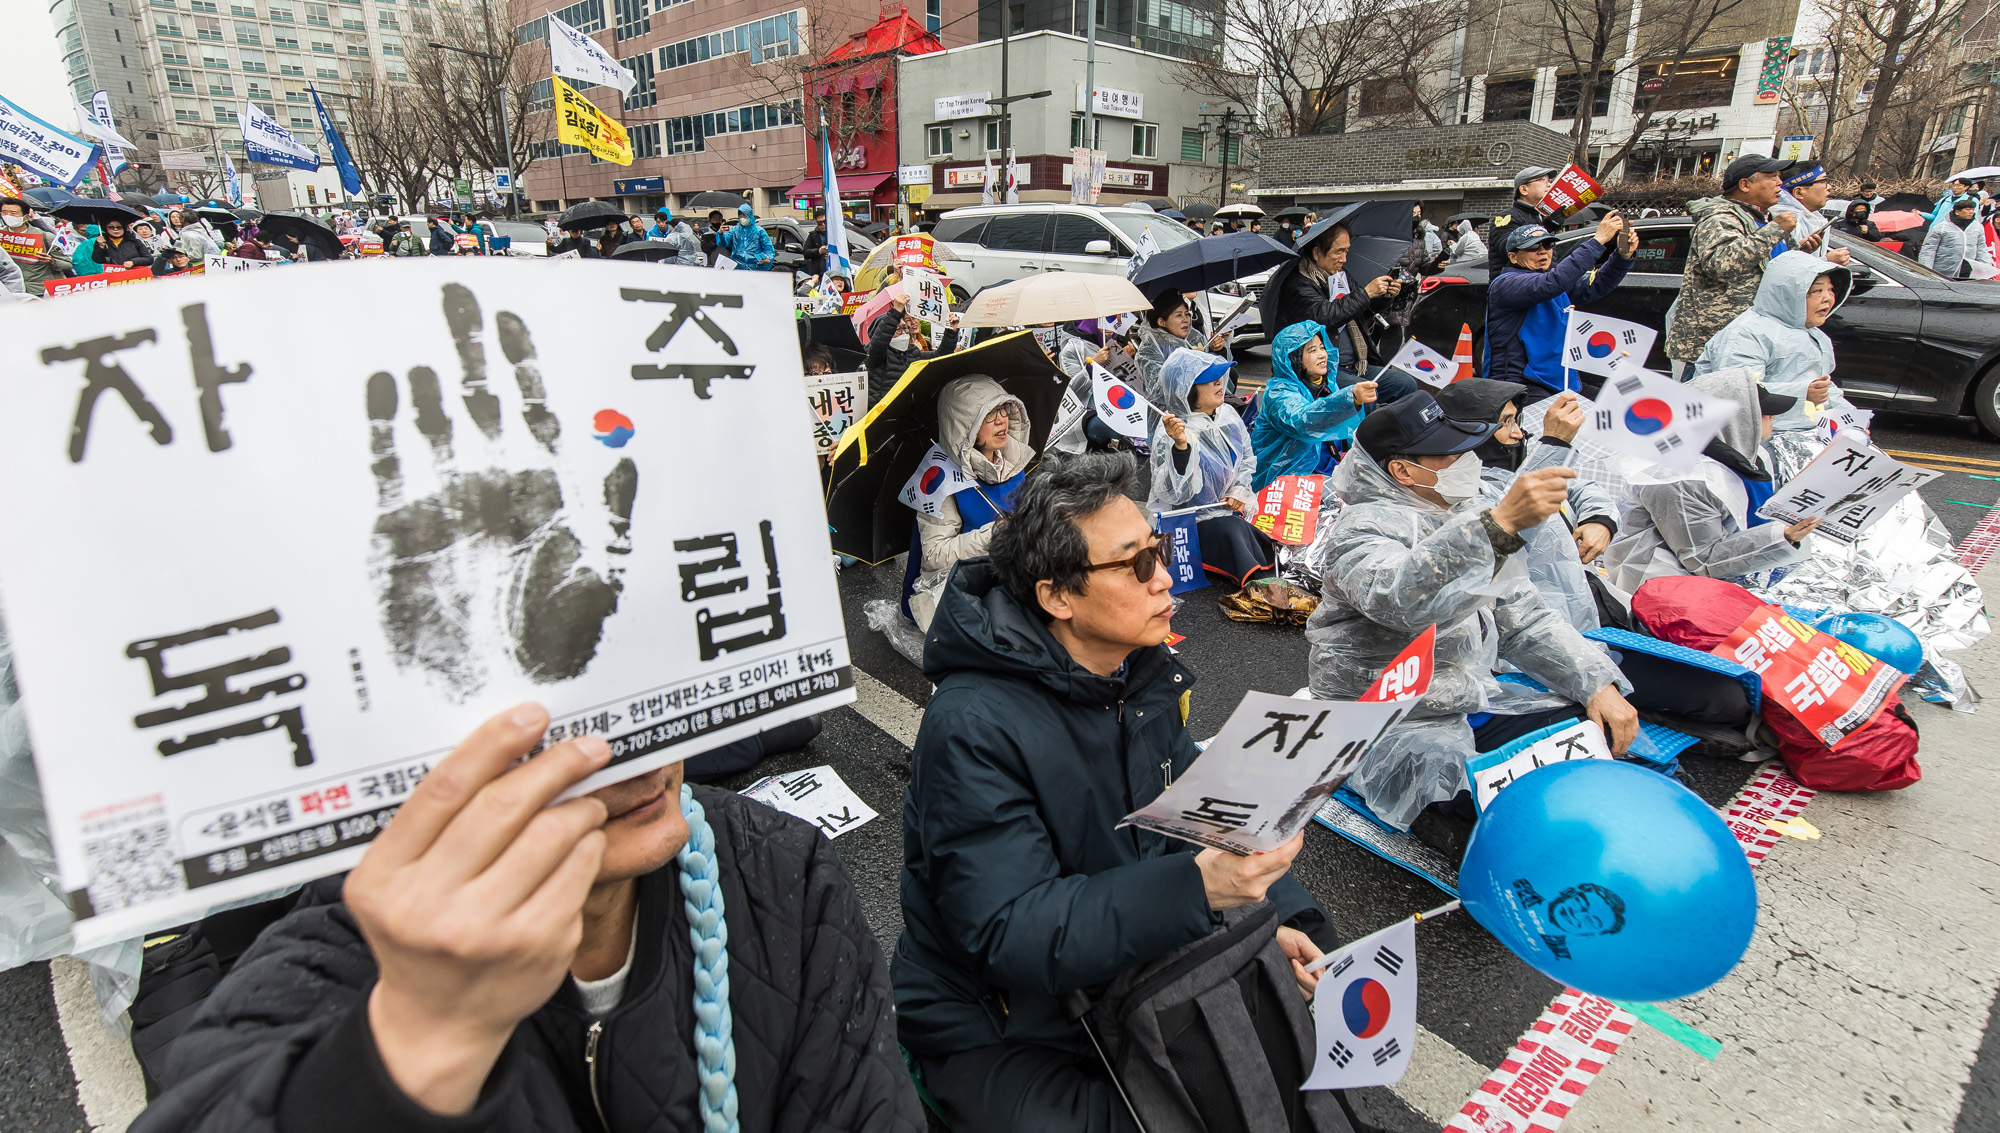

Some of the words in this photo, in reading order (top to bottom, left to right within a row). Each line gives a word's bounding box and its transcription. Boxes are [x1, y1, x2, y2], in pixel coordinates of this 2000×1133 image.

[1111, 104, 1124, 112] Travel
[1561, 170, 1591, 193] 윤석열
[898, 240, 921, 250] 윤석열
[918, 280, 943, 303] 내란
[917, 299, 943, 321] 종식
[37, 302, 254, 463] 자
[619, 286, 757, 400] 주
[807, 386, 855, 416] 내란
[1832, 448, 1876, 477] 자
[1292, 477, 1316, 511] 윤석열
[1282, 509, 1306, 543] 파면!
[126, 608, 316, 767] 독
[673, 519, 788, 662] 립
[1783, 647, 1851, 713] 국힘당
[299, 782, 352, 816] 파면
[628, 676, 734, 724] 헌법재판소로
[739, 659, 789, 690] 모이자!
[1241, 709, 1331, 760] 자
[779, 772, 823, 801] 독
[1500, 1045, 1573, 1119] DANGER!
